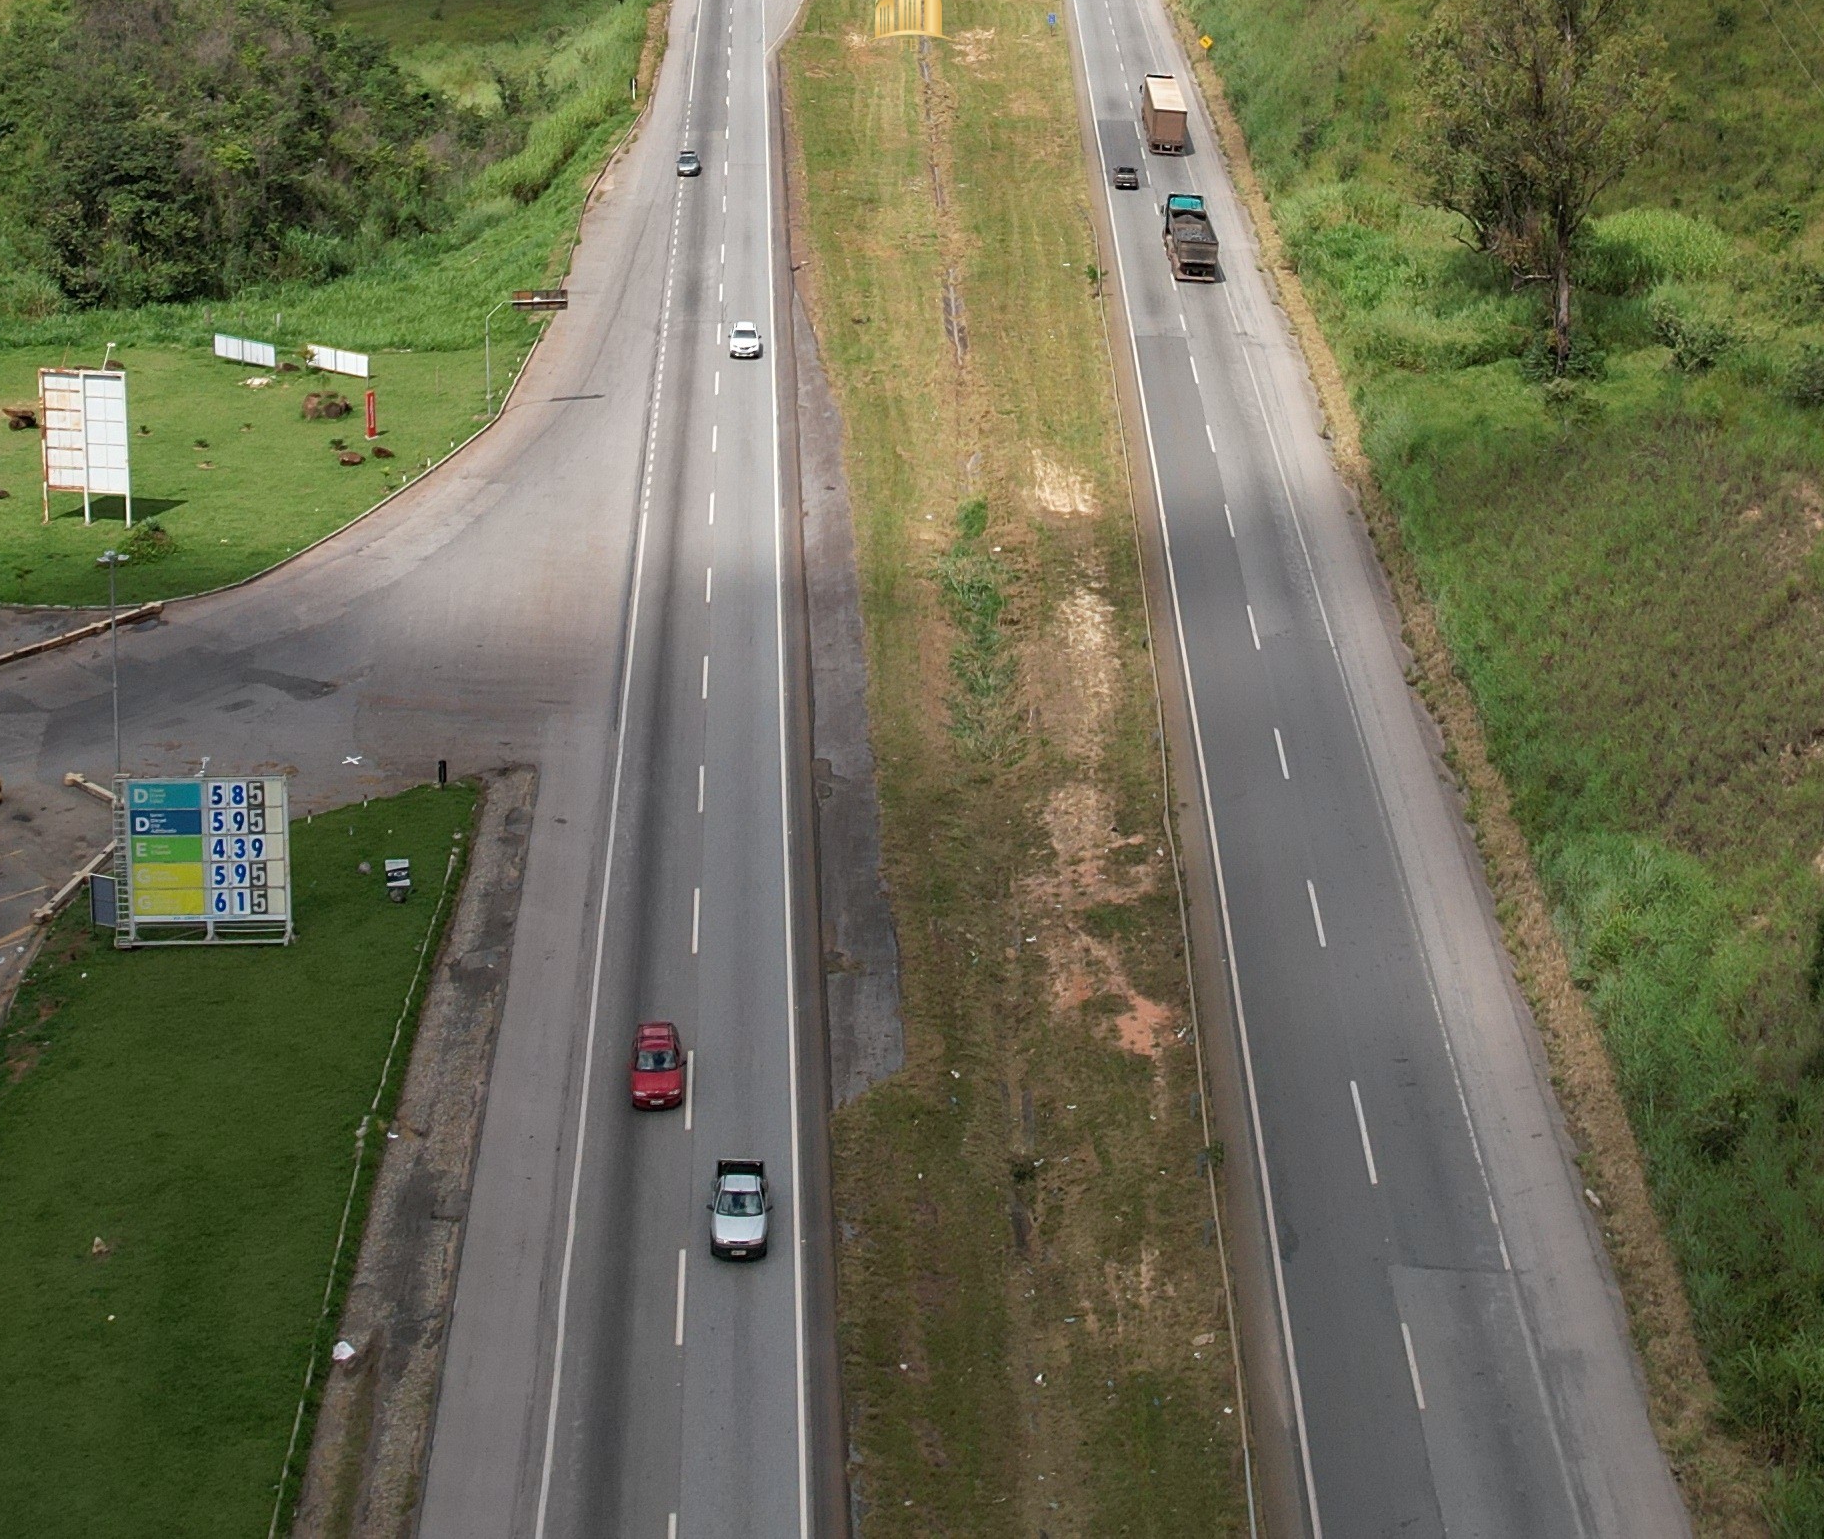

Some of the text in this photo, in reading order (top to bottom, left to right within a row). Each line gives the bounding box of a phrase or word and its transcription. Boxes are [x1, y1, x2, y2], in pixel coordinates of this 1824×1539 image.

[133, 788, 149, 804] D
[135, 817, 150, 832] D
[136, 842, 148, 857] E
[137, 869, 152, 885] G
